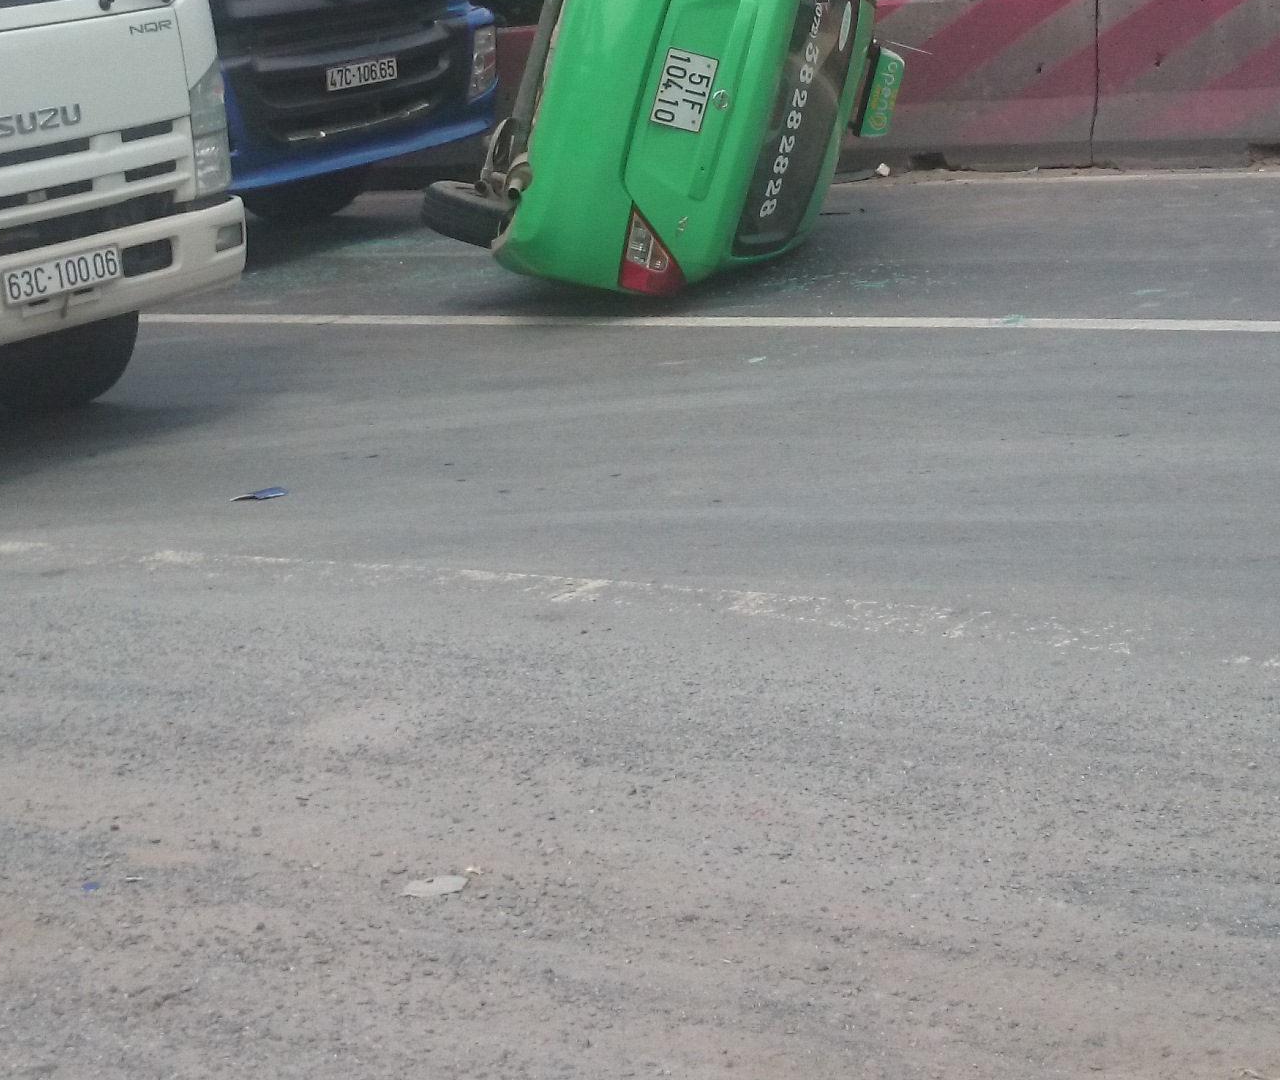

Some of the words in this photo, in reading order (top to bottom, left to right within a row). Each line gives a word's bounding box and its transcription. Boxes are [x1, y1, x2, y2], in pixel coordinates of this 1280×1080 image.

[129, 19, 172, 36] NQR
[654, 54, 692, 123] 104.10
[682, 72, 712, 115] 51F
